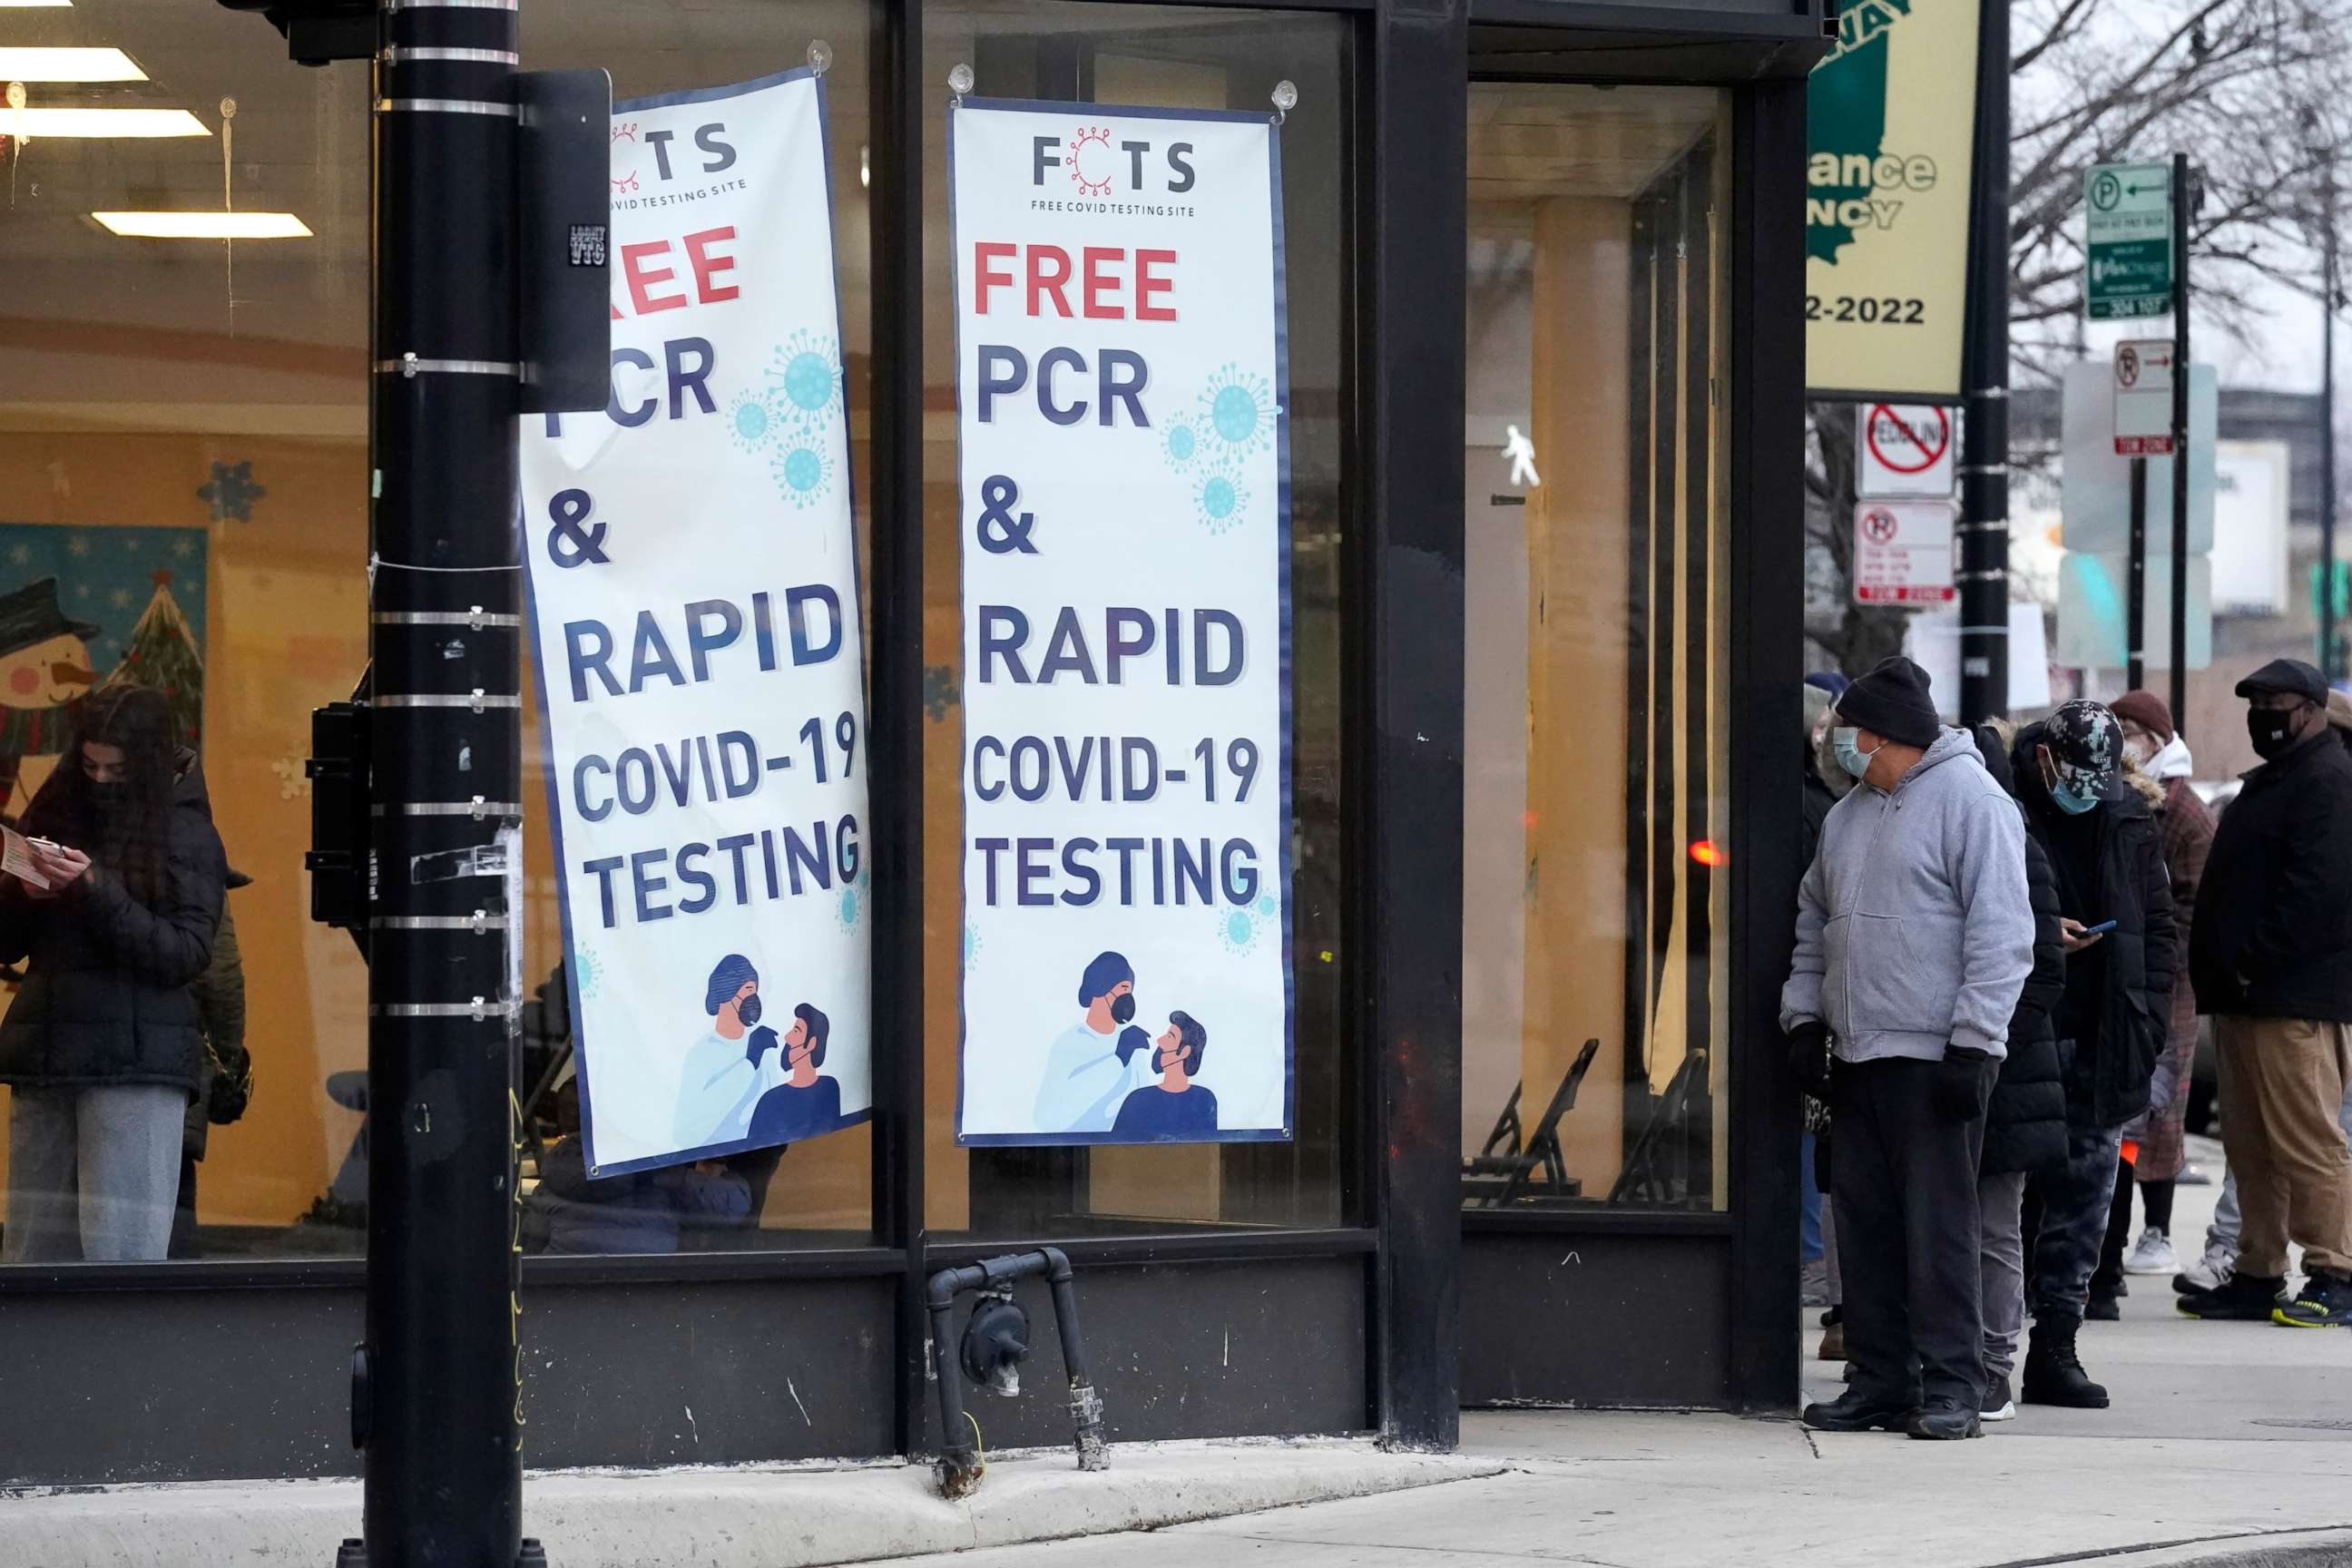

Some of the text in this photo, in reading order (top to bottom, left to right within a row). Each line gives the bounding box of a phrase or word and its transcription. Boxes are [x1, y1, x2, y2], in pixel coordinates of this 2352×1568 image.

[642, 190, 707, 208] TESTING
[711, 179, 747, 196] SITE
[1031, 201, 1194, 217] FREE COVID TESTING SITE
[1808, 152, 1937, 192] ance
[1807, 198, 1904, 230] NCY
[612, 226, 740, 319] EE
[974, 241, 1179, 322] FREE
[1806, 296, 1925, 324] 2-2022
[545, 336, 719, 437] CR
[977, 344, 1151, 428] PCR
[547, 488, 611, 569] &
[975, 475, 1039, 554] &
[564, 583, 843, 701] RAPID
[979, 605, 1245, 686] RAPID
[573, 710, 858, 823] COVID-19
[973, 735, 1259, 803] COVID-19
[583, 814, 859, 929] TESTING
[975, 837, 1259, 907] TESTING
